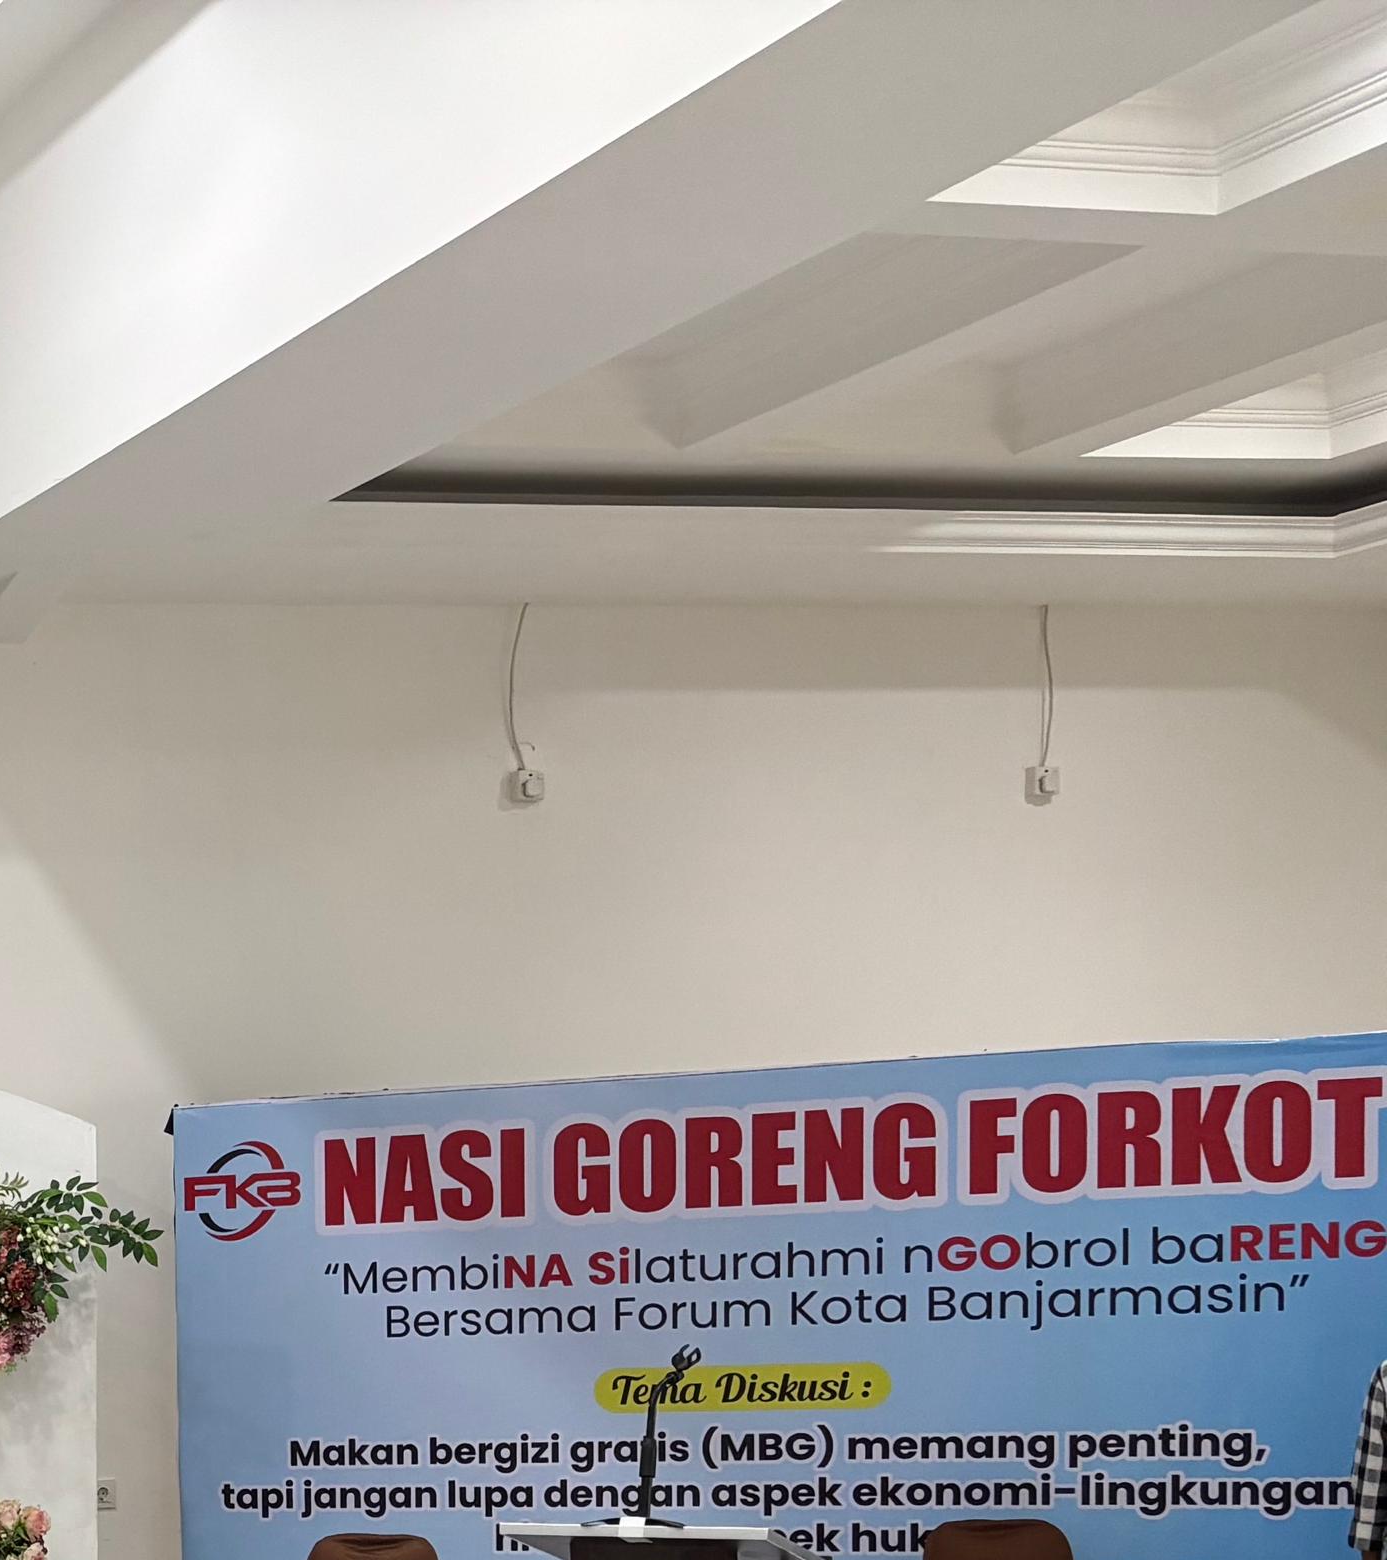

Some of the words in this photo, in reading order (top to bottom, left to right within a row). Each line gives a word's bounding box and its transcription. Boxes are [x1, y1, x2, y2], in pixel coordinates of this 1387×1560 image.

[324, 1128, 526, 1226] NASI
[554, 1103, 937, 1216] GORENG
[969, 1077, 1383, 1195] FORKOT
[183, 1171, 302, 1211] FKB
[588, 1236, 884, 1286] Silaturahmi
[905, 1228, 1130, 1274] nGObrol
[1152, 1220, 1387, 1266] baRENG
[386, 1302, 596, 1338] Bersama
[614, 1296, 771, 1332] Forum
[791, 1290, 908, 1325] Kota
[715, 1372, 853, 1406] Diskusi
[290, 1439, 419, 1467] Makan
[429, 1433, 560, 1474] bergizi
[570, 1431, 689, 1472] grais
[702, 1425, 833, 1469] (MBG)
[848, 1432, 1055, 1468] memang
[1069, 1424, 1267, 1467] penting,
[222, 1481, 294, 1518] tapi
[300, 1482, 437, 1518] jangan
[447, 1480, 535, 1517] lupa
[544, 1478, 700, 1516] dengan
[712, 1475, 842, 1516] aspek
[852, 1522, 930, 1552] huk
